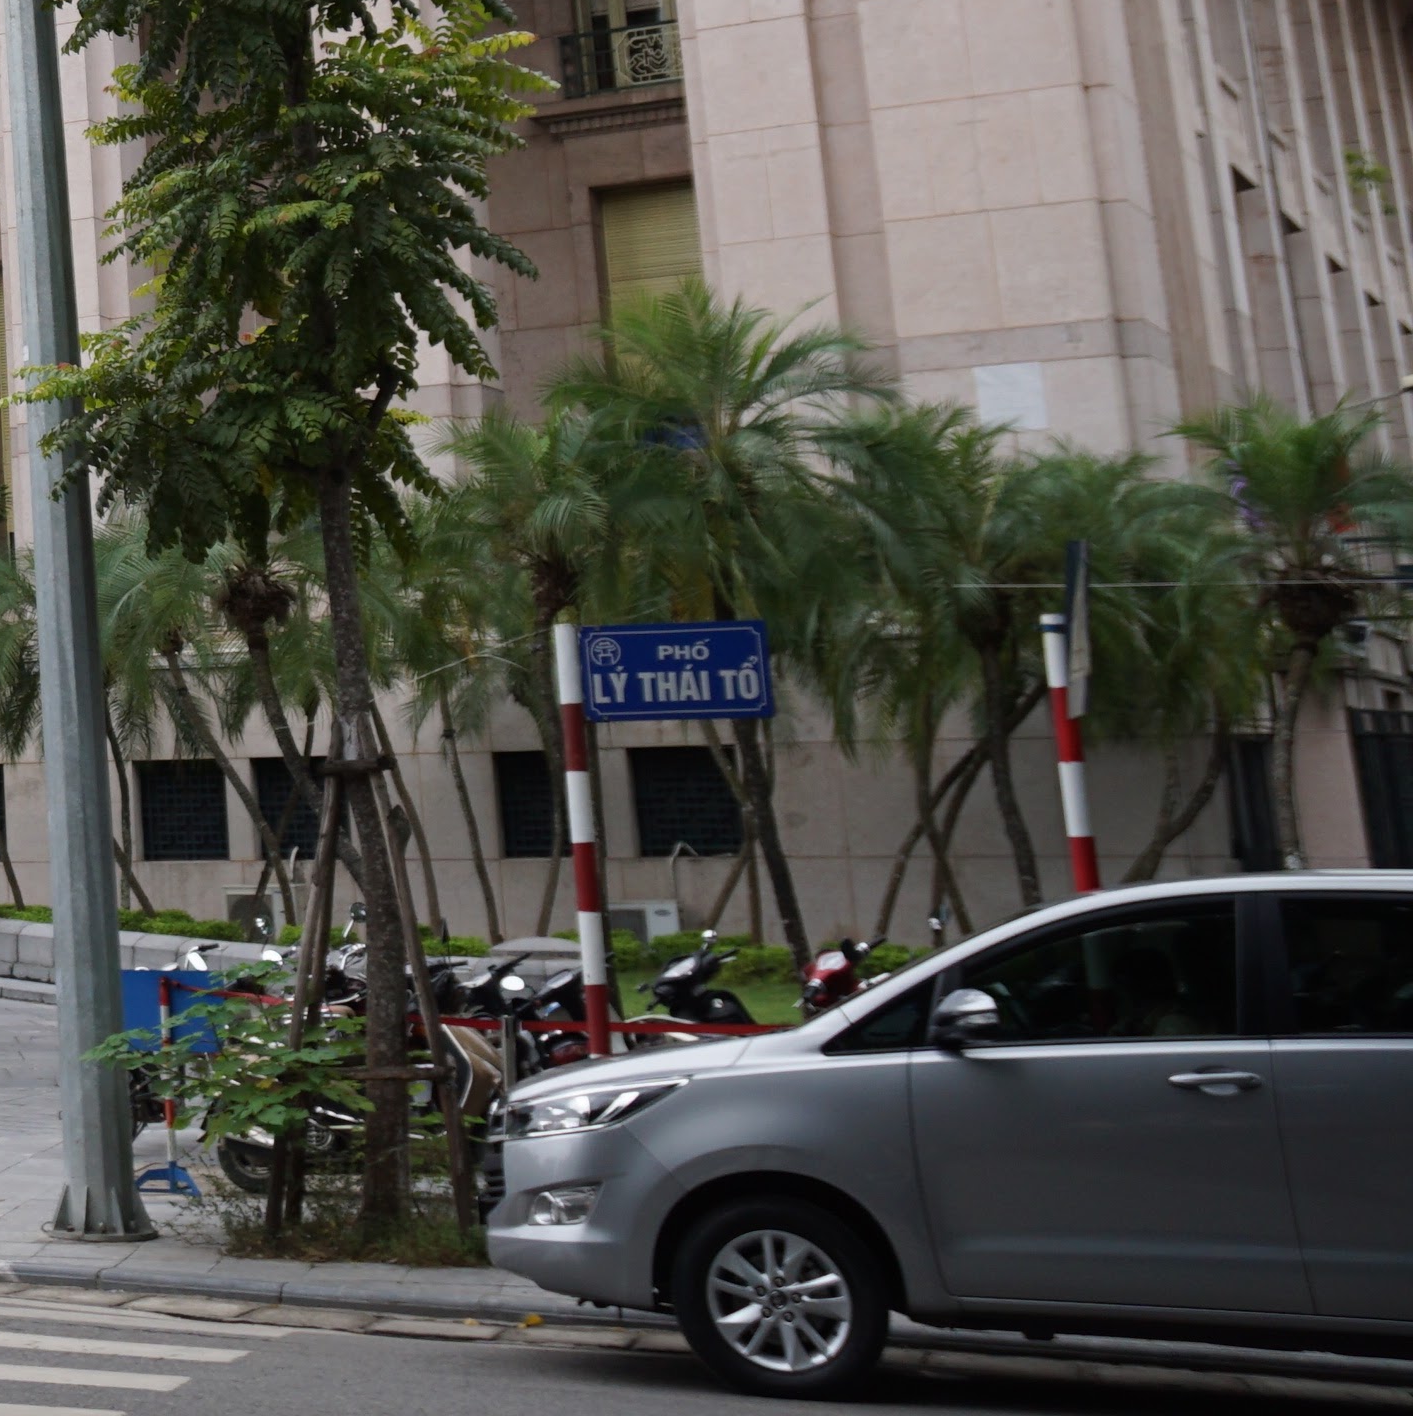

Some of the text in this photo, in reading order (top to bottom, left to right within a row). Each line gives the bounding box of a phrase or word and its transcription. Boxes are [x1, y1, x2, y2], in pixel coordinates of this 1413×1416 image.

[657, 638, 712, 661] PHỐ
[593, 654, 760, 704] LÝ THÁI TỔ
